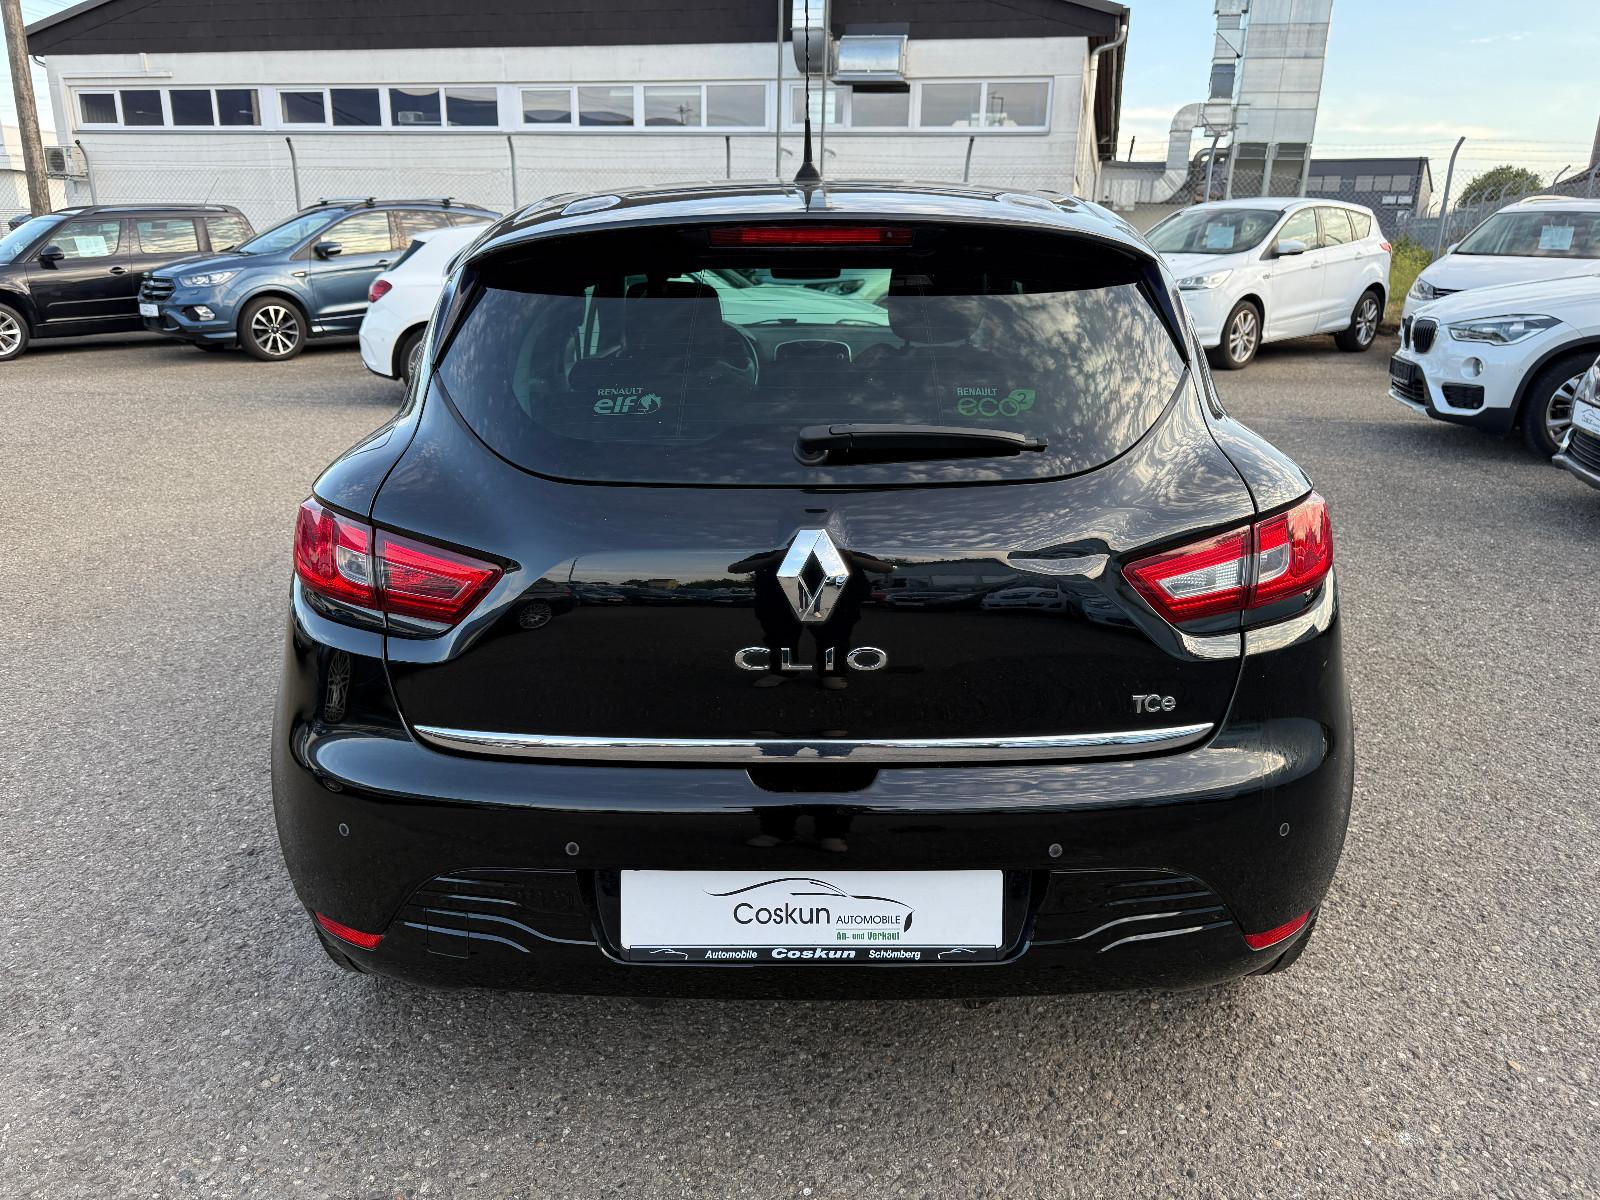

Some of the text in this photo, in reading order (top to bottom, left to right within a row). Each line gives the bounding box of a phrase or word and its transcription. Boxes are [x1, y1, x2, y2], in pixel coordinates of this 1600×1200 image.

[597, 387, 644, 396] RENAULT
[957, 387, 998, 396] RENAULT
[593, 396, 638, 414] elf
[734, 646, 888, 671] CLIO
[1132, 693, 1177, 714] TCe
[733, 902, 901, 925] Coskun AUTOMOBILE
[852, 932, 865, 940] und
[867, 931, 900, 941] Verkauf
[704, 947, 921, 961] Automobile Coskun Schömberg
